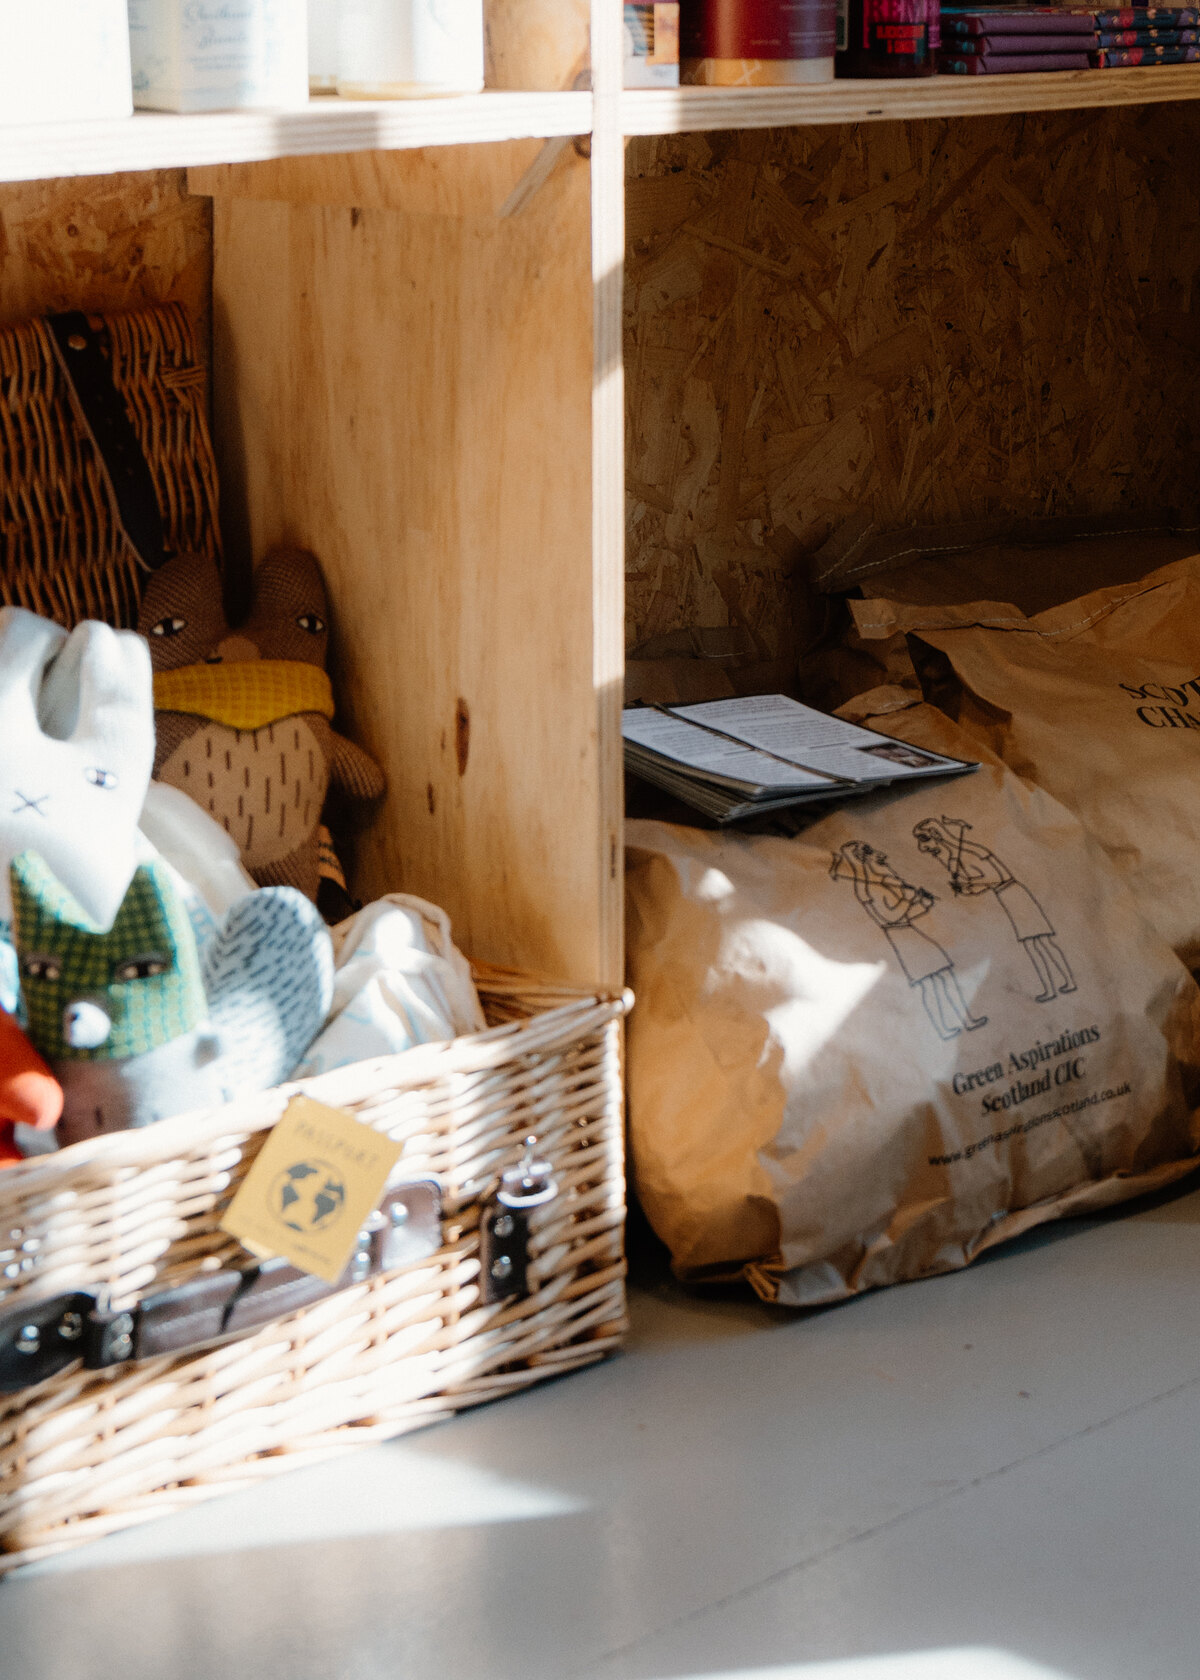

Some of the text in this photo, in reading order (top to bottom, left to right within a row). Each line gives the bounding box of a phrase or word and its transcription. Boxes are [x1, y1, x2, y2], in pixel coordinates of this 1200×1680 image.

[952, 1024, 1101, 1096] Green Aspirations
[981, 1056, 1087, 1116] Scotland CIC
